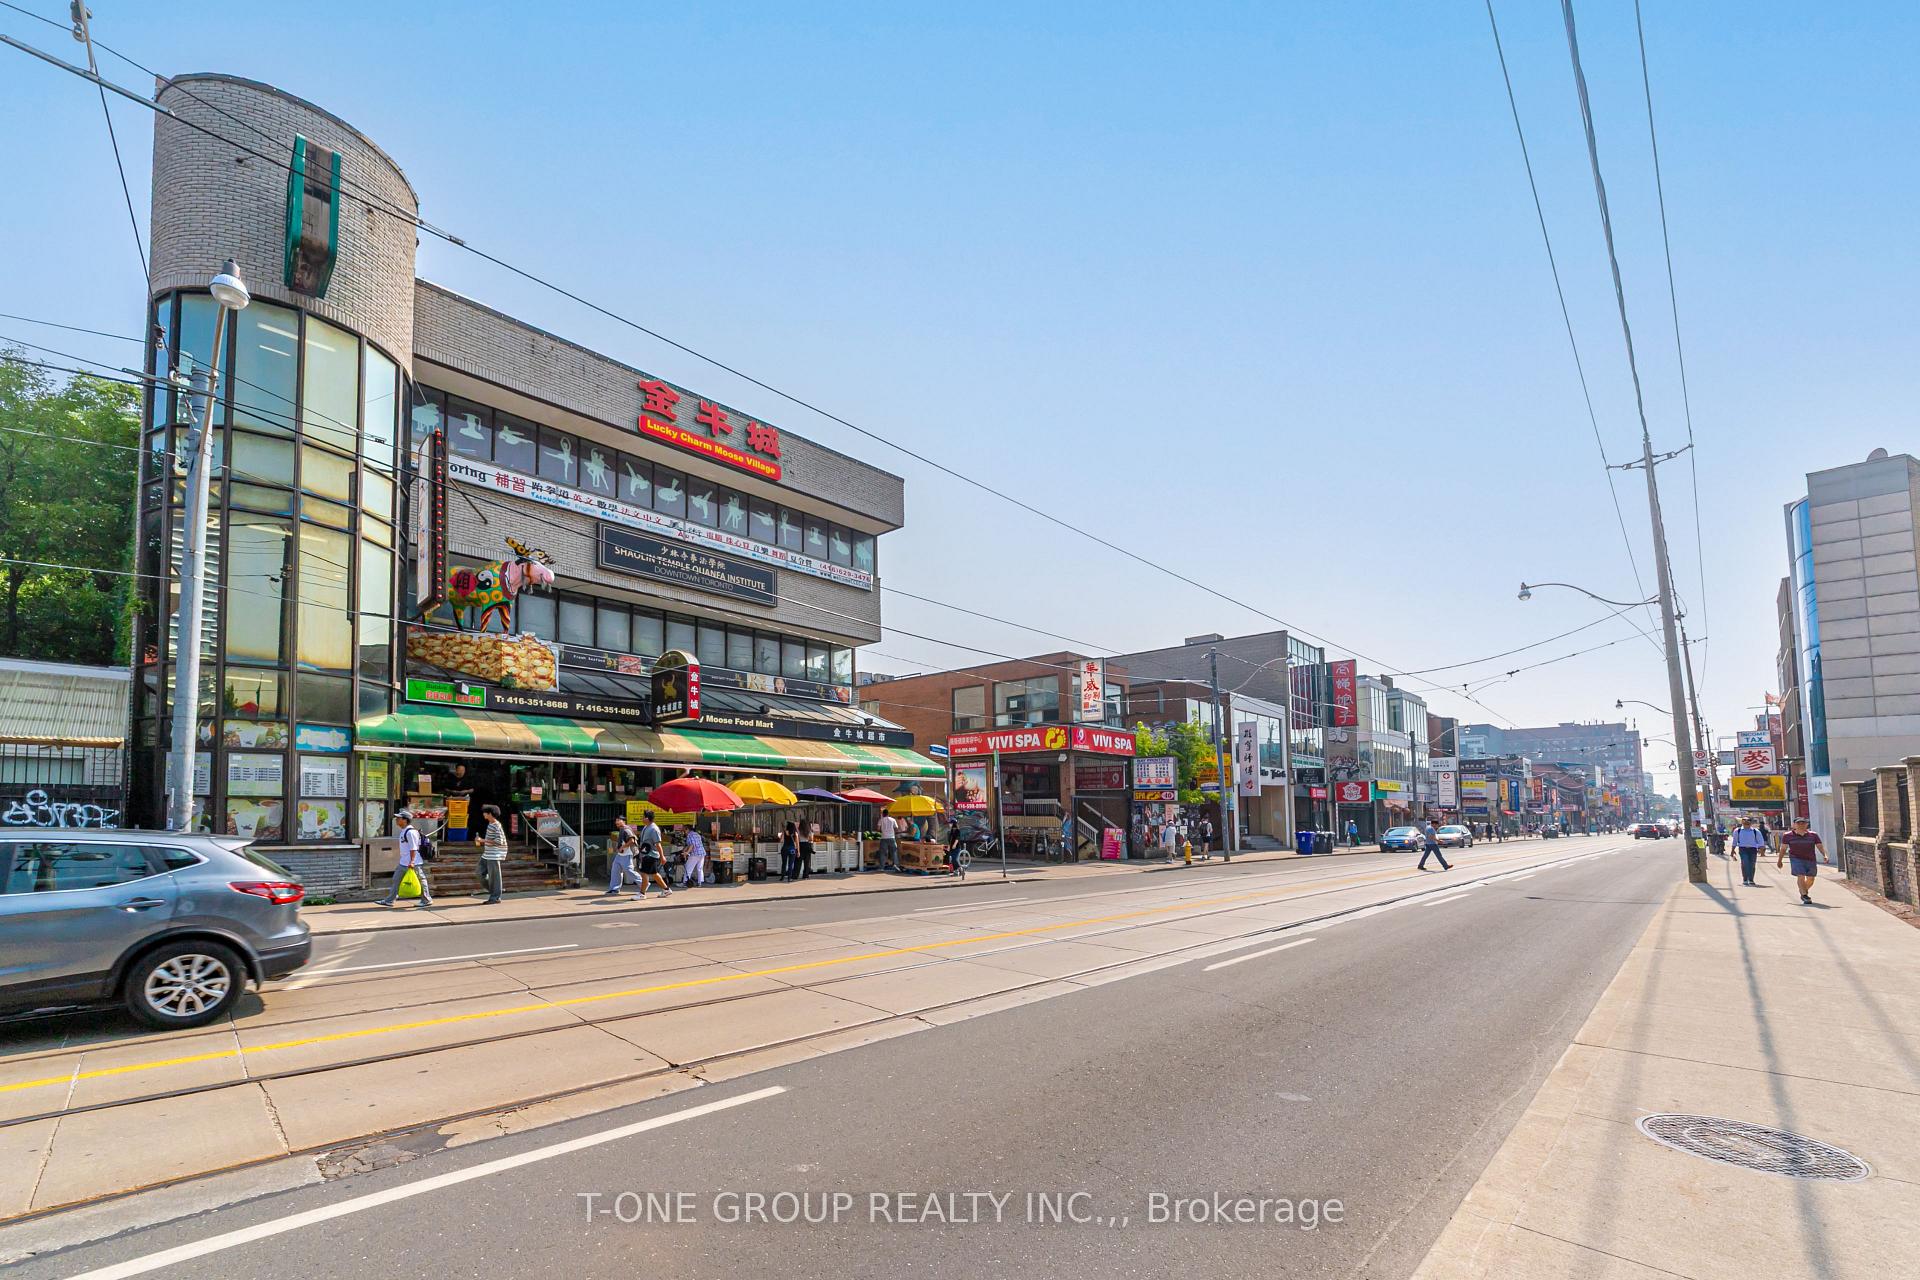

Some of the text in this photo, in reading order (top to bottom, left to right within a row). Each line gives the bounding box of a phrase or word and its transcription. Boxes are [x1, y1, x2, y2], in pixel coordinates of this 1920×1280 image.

[637, 380, 782, 459] 金牛城
[647, 419, 775, 474] Lucky Charm Moose Village
[495, 472, 526, 493] 補習
[614, 546, 766, 590] SHAOLIN TEMPLE QUANFA INSTITUTE
[654, 566, 733, 591] DOWNTOWN TORONTO
[690, 672, 699, 709] 金牛城
[495, 695, 640, 716] T: 416-351-8688 F: 416-351-8689
[706, 715, 733, 724] Moose
[735, 718, 753, 727] Food
[833, 728, 886, 741] 金牛城超市
[987, 736, 1013, 749] VIVI
[1015, 734, 1040, 747] SPA
[1093, 735, 1132, 750] VIVI SPA
